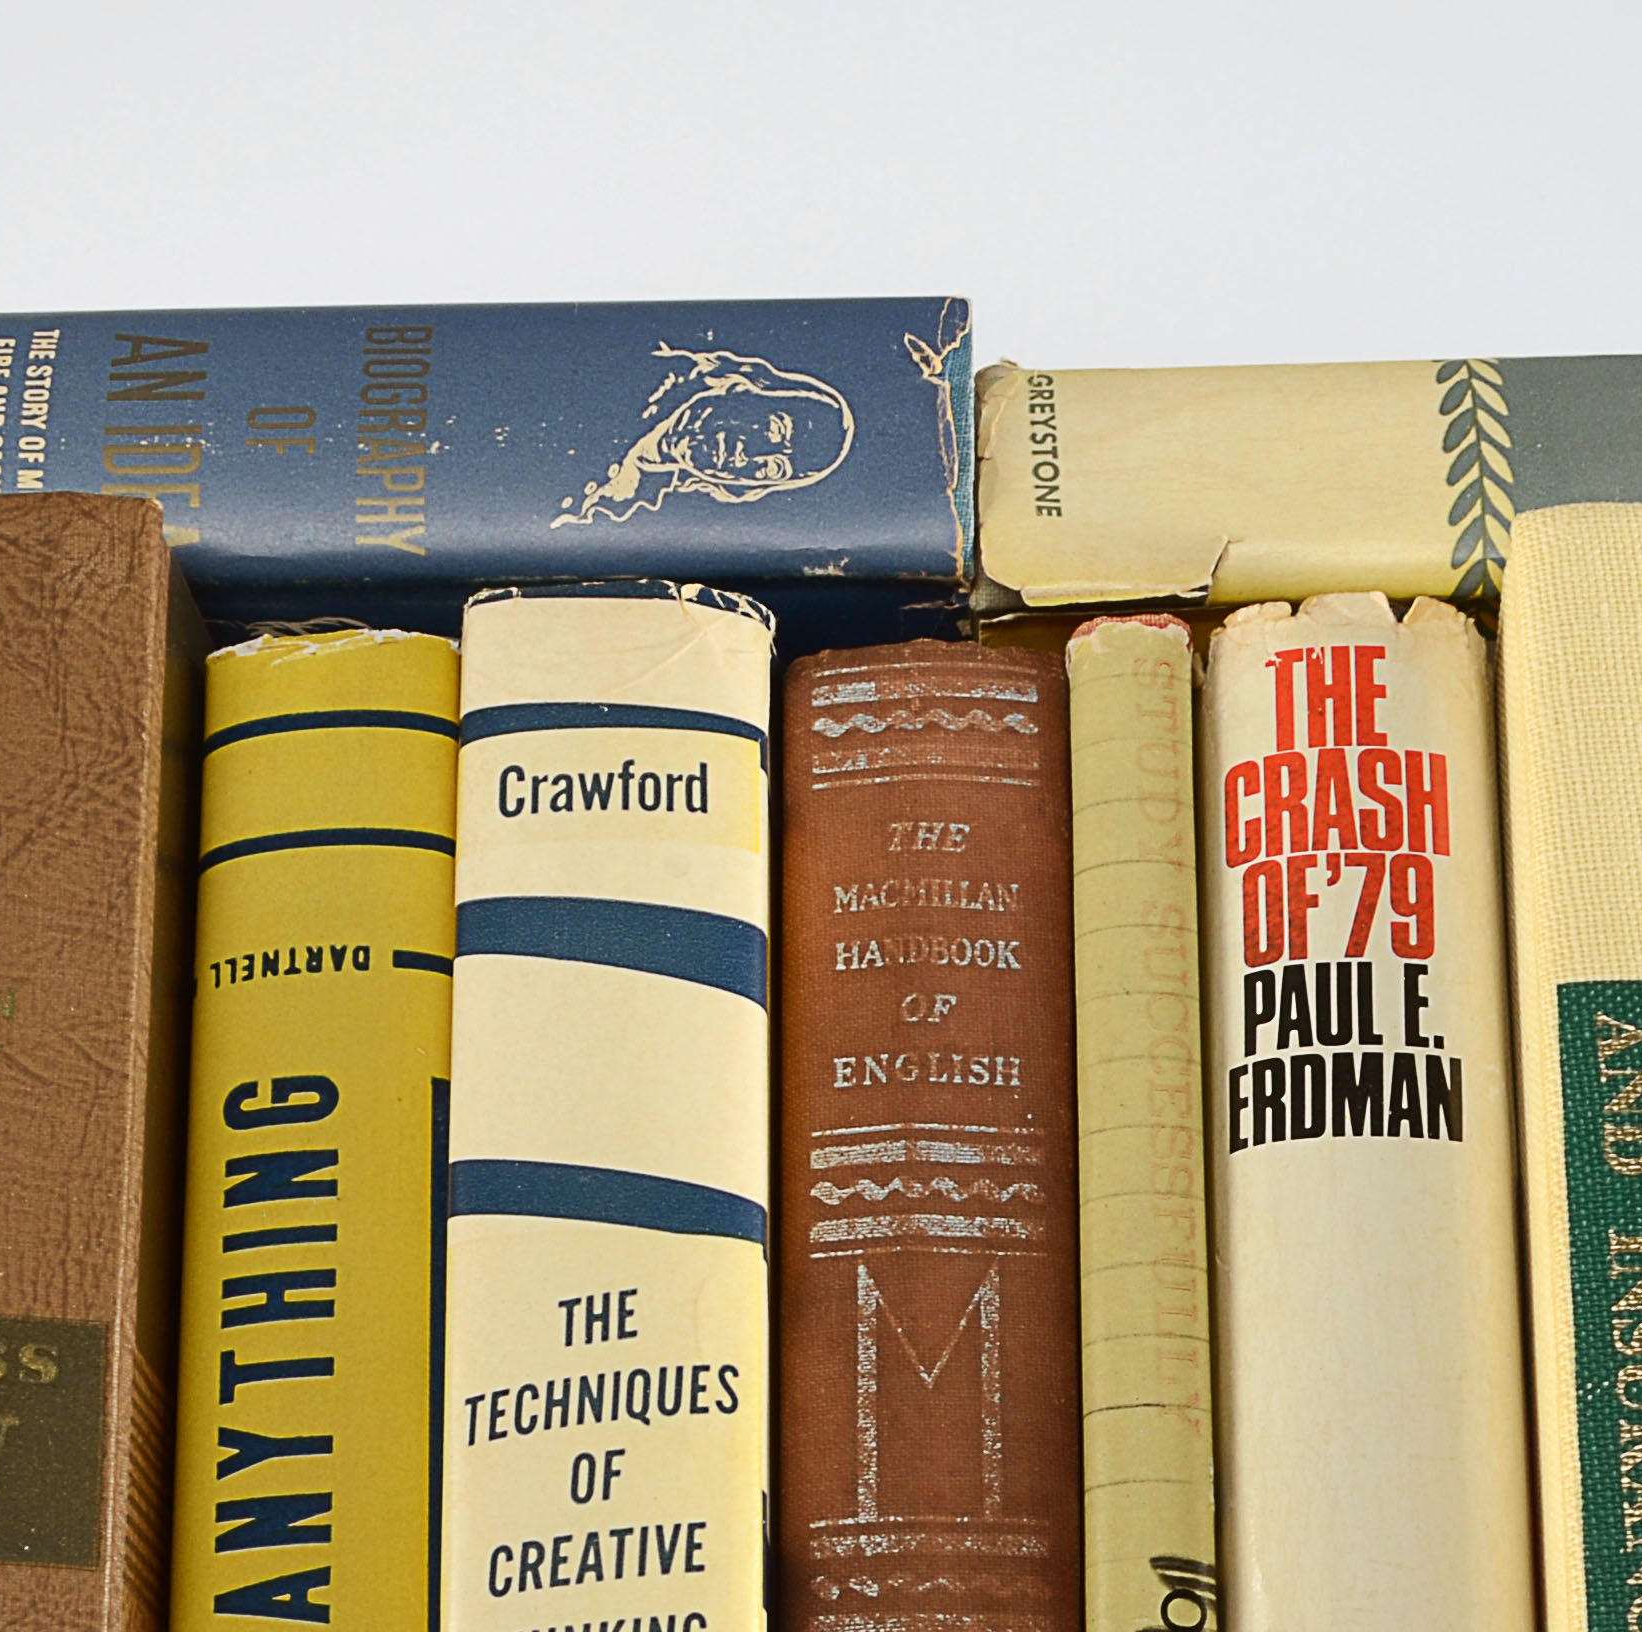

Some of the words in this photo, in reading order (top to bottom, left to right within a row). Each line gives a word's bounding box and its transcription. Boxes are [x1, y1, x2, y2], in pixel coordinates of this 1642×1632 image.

[29, 328, 61, 361] THE
[106, 332, 210, 402] AN
[21, 362, 55, 431] STORY
[17, 433, 47, 466] OF
[246, 405, 317, 456] OF
[356, 325, 434, 557] BIOGRAPHY
[1027, 373, 1064, 520] GREYSTONE
[1265, 645, 1389, 752] THE
[498, 759, 709, 818] Crawford
[1224, 747, 1451, 869] CRASH
[888, 821, 972, 853] THE
[832, 878, 1021, 915] MACMILLAN
[1241, 853, 1320, 969] OF
[209, 944, 371, 989] DARTNELL
[834, 935, 1022, 972] HANDBOOK
[900, 992, 958, 1024] OF
[1243, 961, 1383, 1058] PAUL
[1403, 963, 1445, 1050] E.
[832, 1052, 1022, 1089] ENGLISH
[1228, 1051, 1464, 1151] ERDMAN
[213, 1073, 341, 1625] ANYTHING
[557, 1287, 639, 1348] THE
[463, 1363, 740, 1447] TECHNIQUES
[569, 1447, 626, 1505] OF
[487, 1521, 707, 1598] CREATIVE
